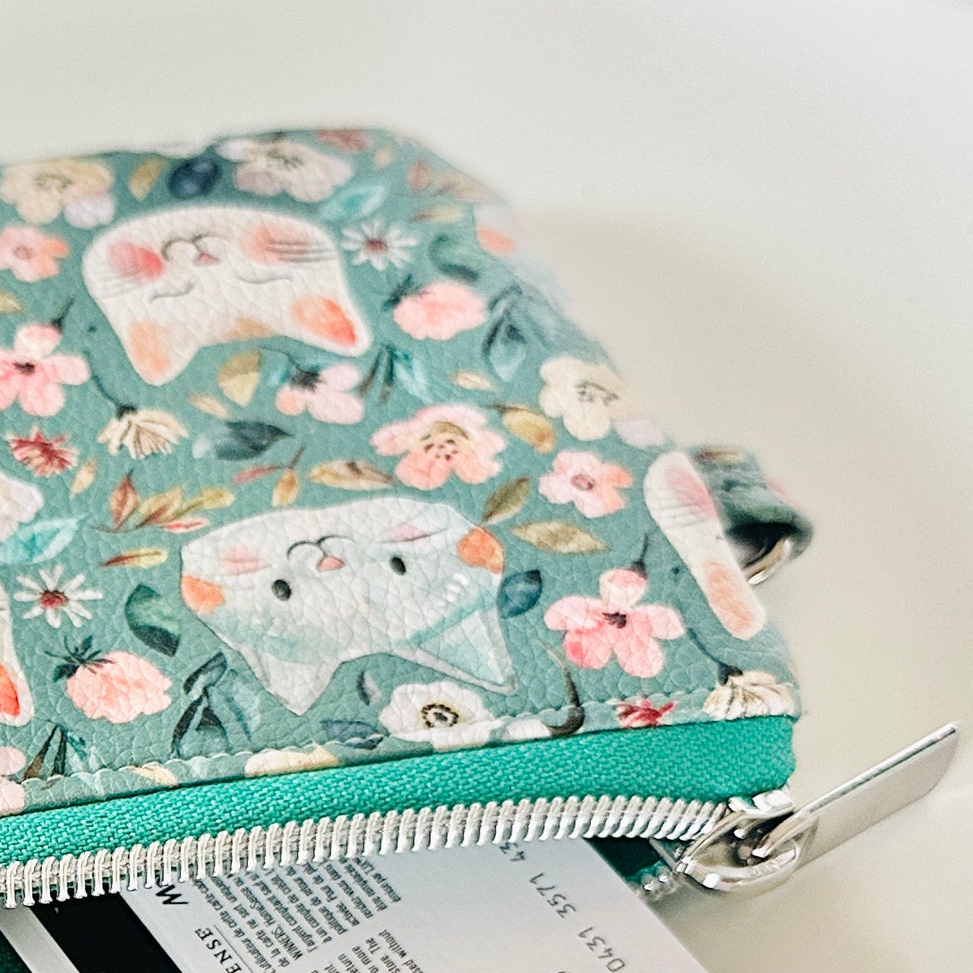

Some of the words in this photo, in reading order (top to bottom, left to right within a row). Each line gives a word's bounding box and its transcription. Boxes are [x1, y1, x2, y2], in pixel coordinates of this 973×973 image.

[527, 871, 578, 920] 3571
[351, 944, 373, 967] more
[364, 936, 382, 956] The
[377, 928, 408, 960] without
[576, 925, 629, 973] 0431
